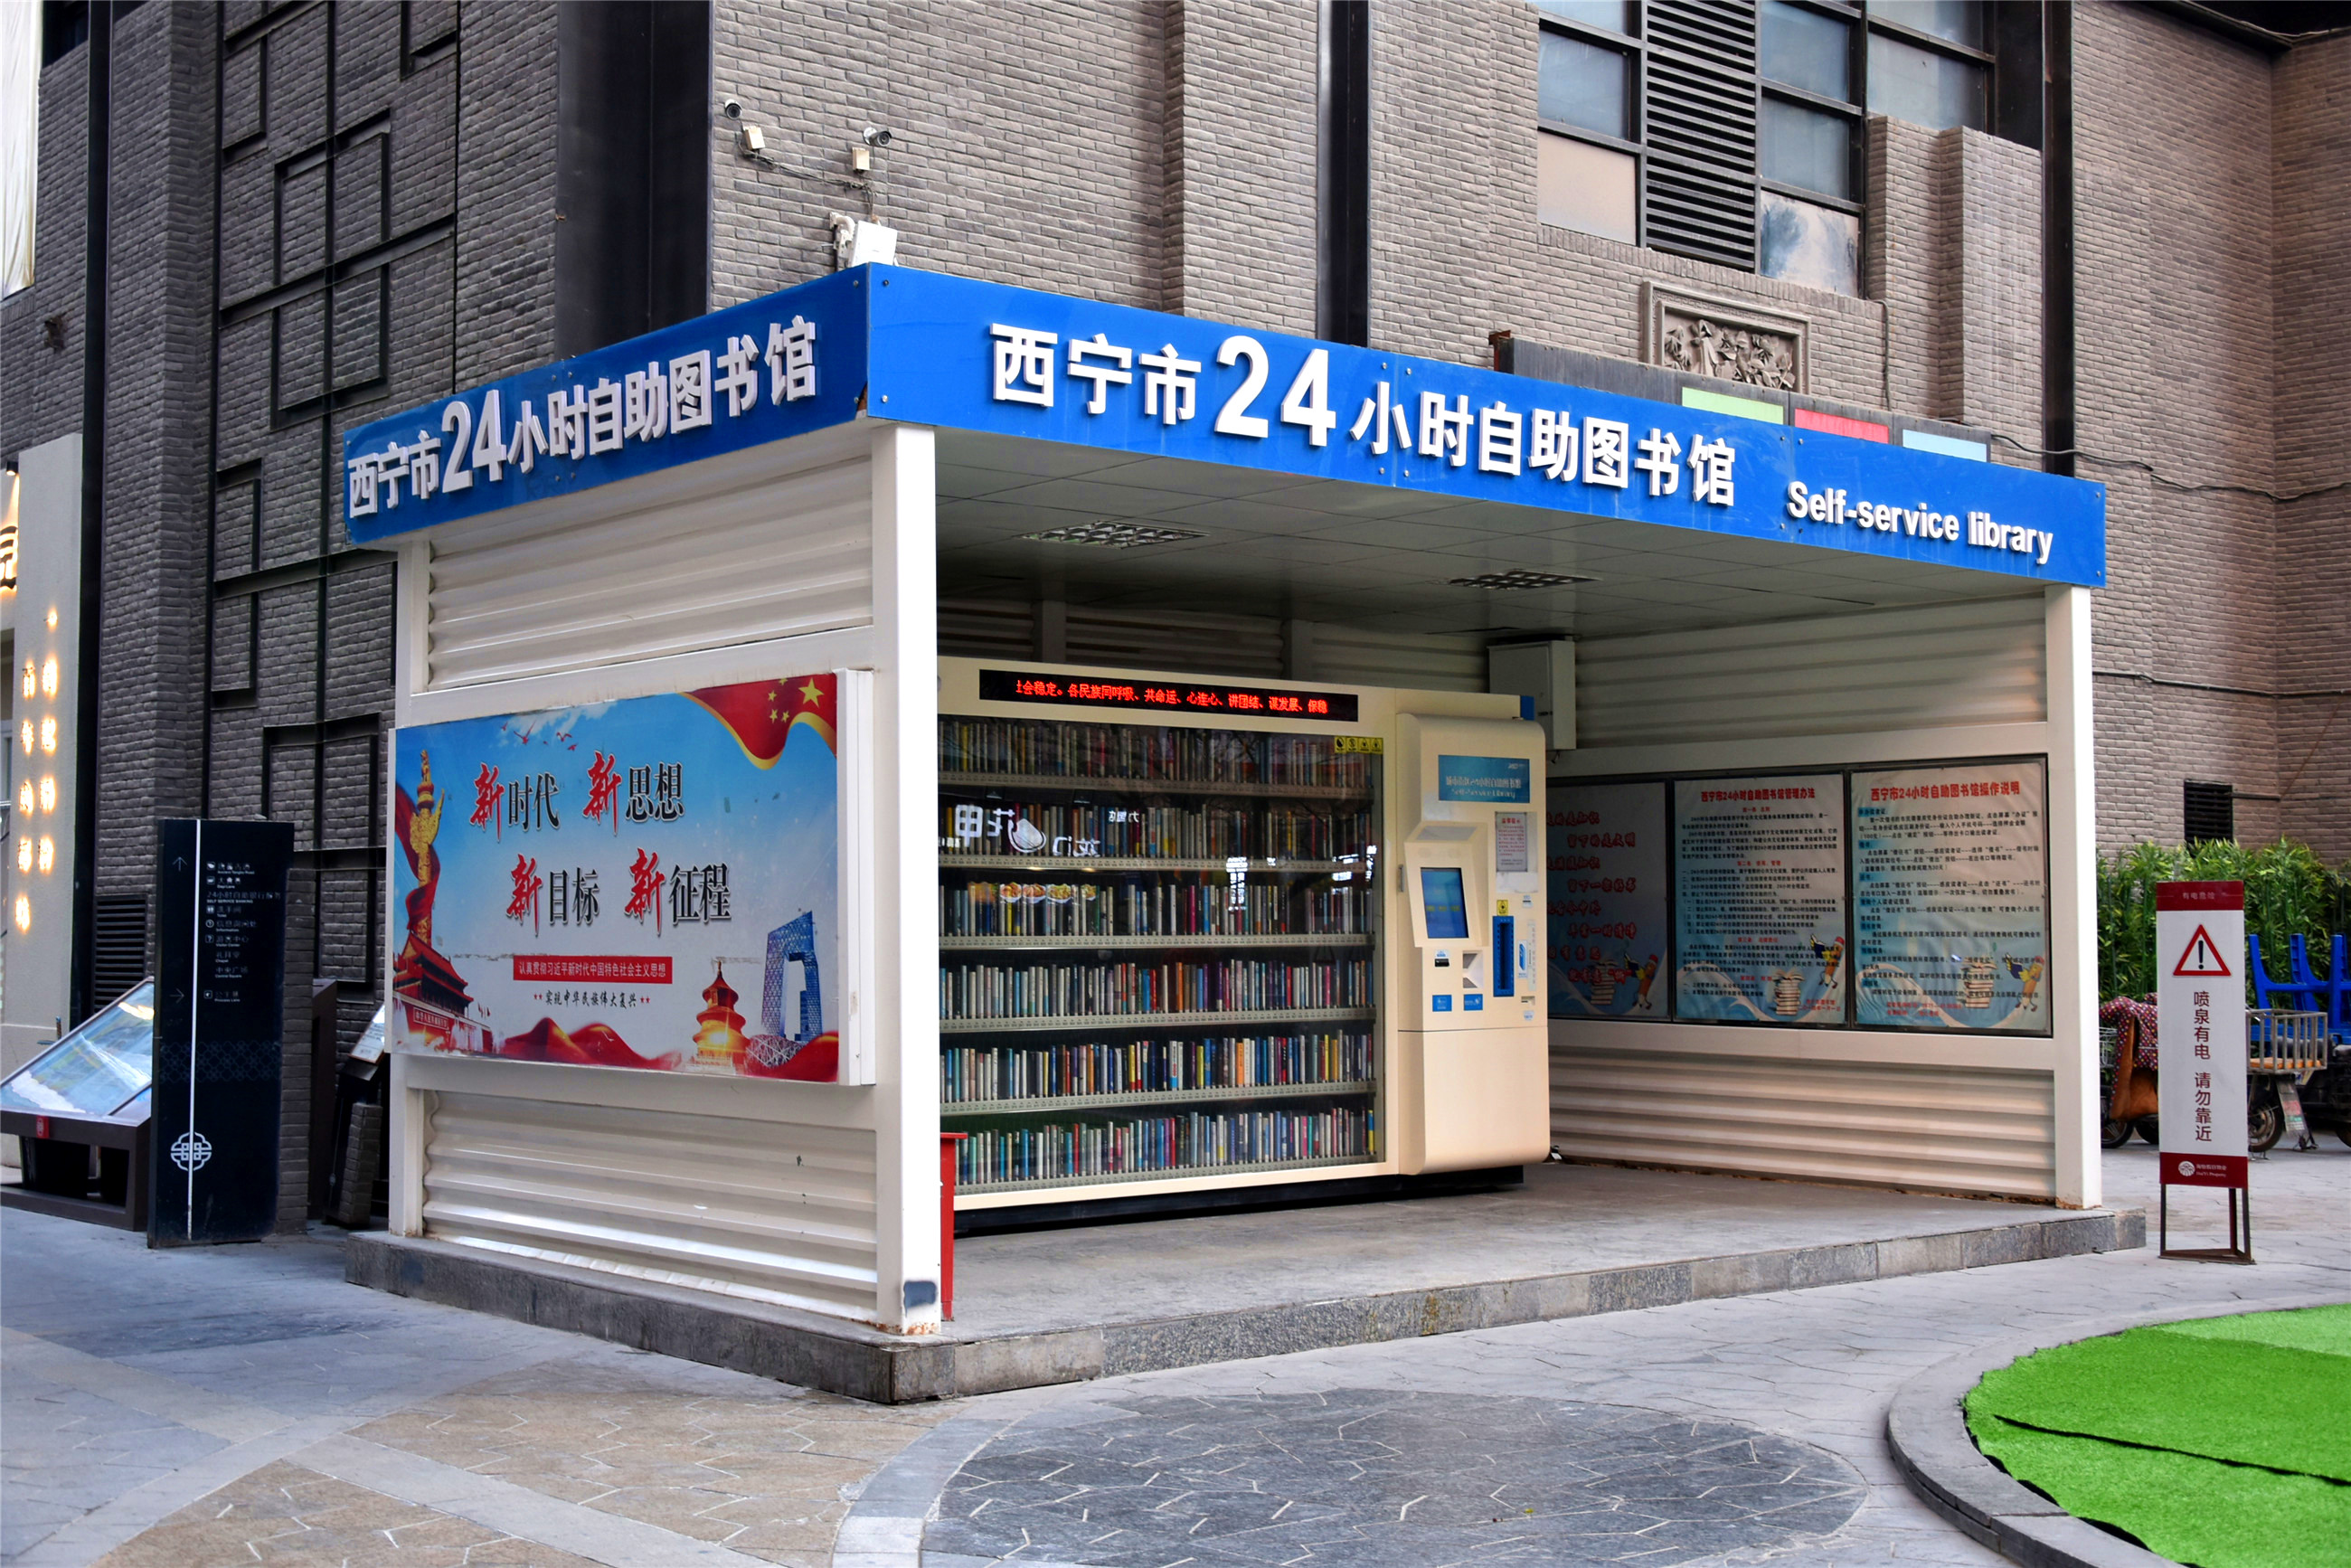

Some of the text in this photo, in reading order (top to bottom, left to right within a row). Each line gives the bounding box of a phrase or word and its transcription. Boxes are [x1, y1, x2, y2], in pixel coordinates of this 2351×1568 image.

[348, 315, 816, 519] 西宁市24小时自助图书馆
[989, 323, 1736, 506] 西宁市24小时自助图书馆
[1786, 480, 2054, 565] Self-service library
[469, 750, 686, 841] 新时代 新思想
[1871, 780, 2021, 802] 西宁市24小时自助图书馆操作说明
[505, 847, 732, 937] 新目标 新征程
[518, 961, 667, 978] 认真贯彻习近平新时代中国特色社会主义思想
[2193, 990, 2211, 1061] 喷泉有电
[2194, 1071, 2212, 1142] 请勿靠近
